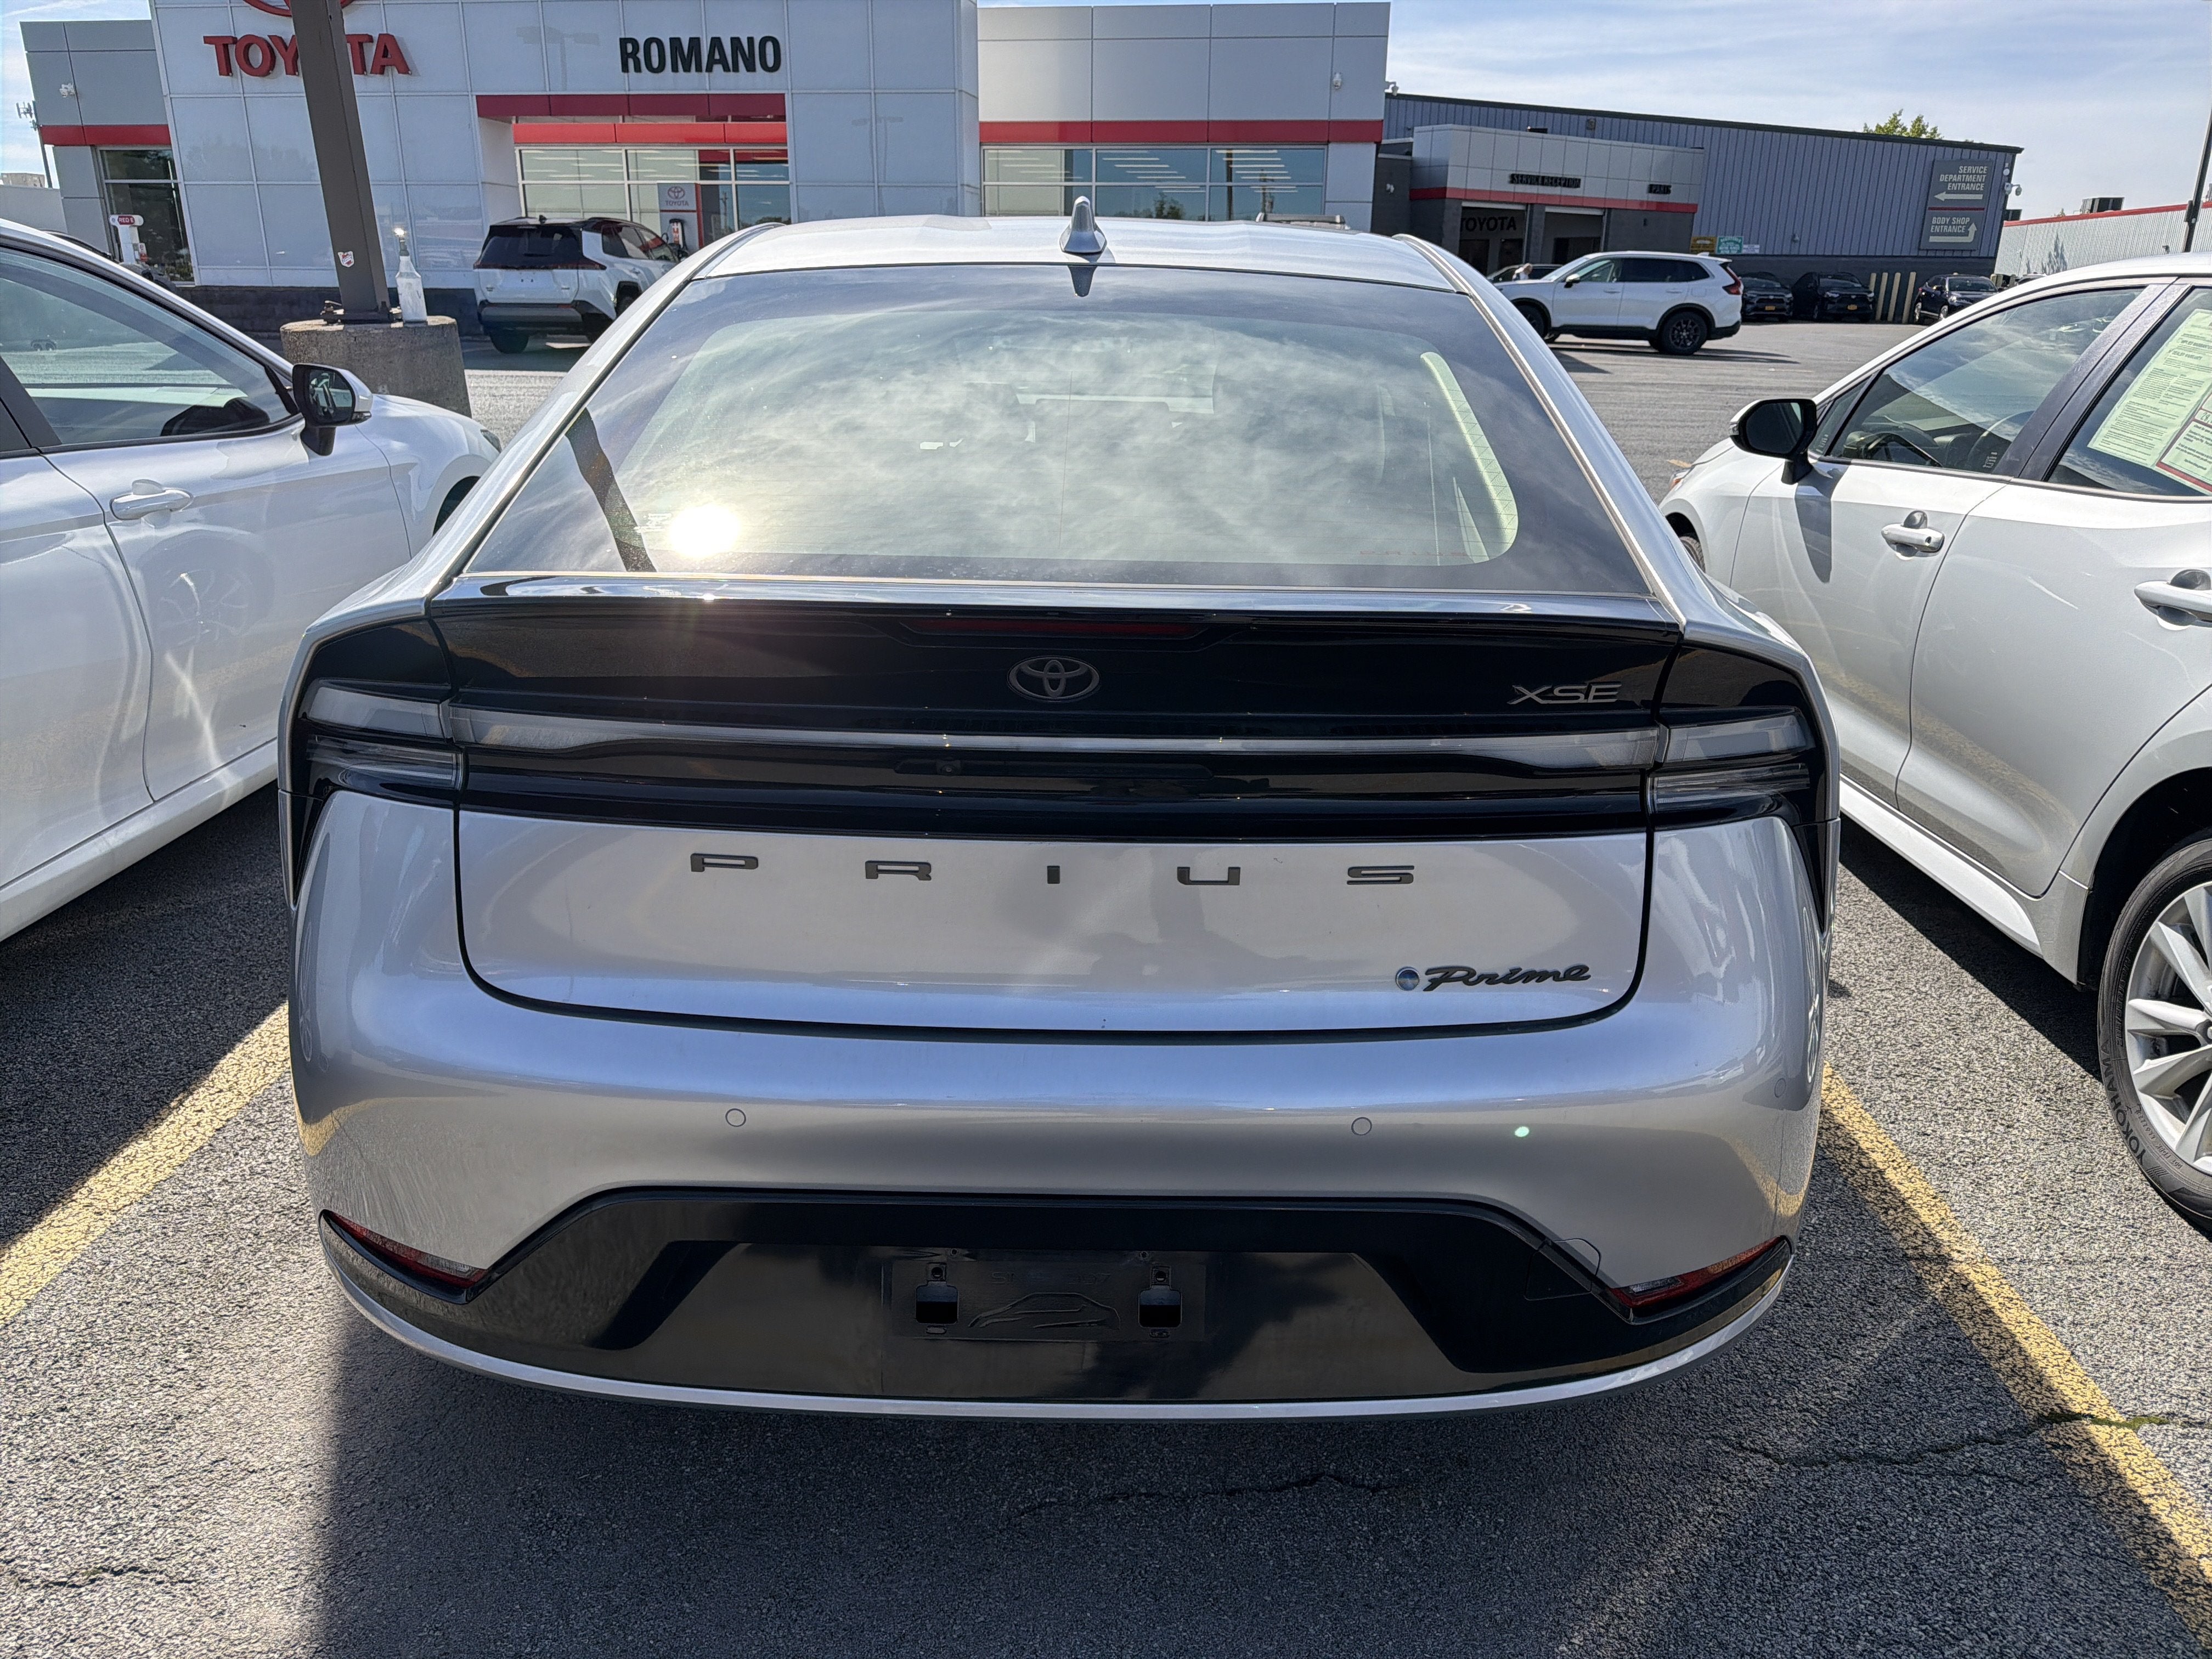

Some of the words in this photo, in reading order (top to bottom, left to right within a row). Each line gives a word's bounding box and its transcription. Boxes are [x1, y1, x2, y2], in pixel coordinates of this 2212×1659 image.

[203, 33, 411, 76] TOYTA
[619, 36, 781, 73] ROMANO
[1507, 684, 1622, 704] XSE
[691, 853, 1414, 887] PRIUS
[1423, 964, 1592, 992] Prime
[2100, 1040, 2146, 1166] YOKOHAMA
